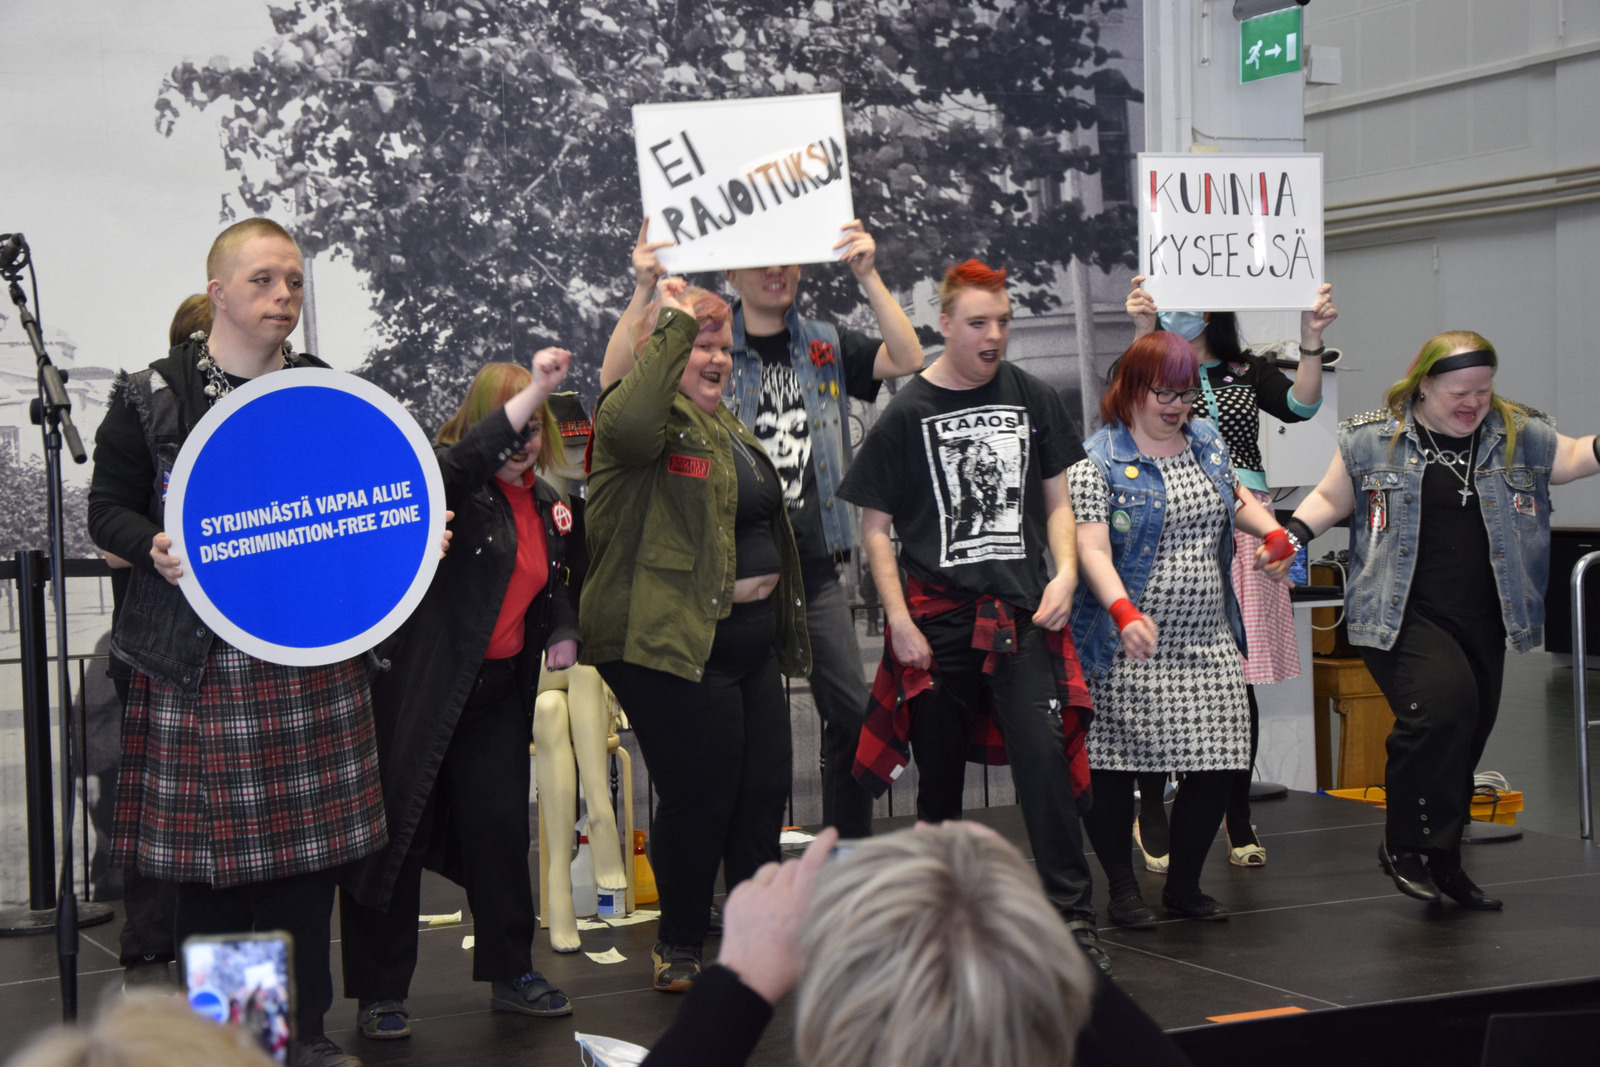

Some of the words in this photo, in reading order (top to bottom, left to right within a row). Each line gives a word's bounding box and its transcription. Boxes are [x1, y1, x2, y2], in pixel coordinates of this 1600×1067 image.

[649, 129, 706, 188] EI
[1150, 171, 1296, 216] KUNNIA
[1149, 228, 1314, 279] KYSEESSÄ
[941, 415, 1016, 433] KAAOS
[200, 513, 377, 564] DISCRIMINATION-FREE
[379, 504, 421, 528] ZONE
[201, 495, 313, 537] SYRJINNÄSTÄ
[315, 489, 368, 515] VAPAA
[372, 480, 412, 505] ALUE
